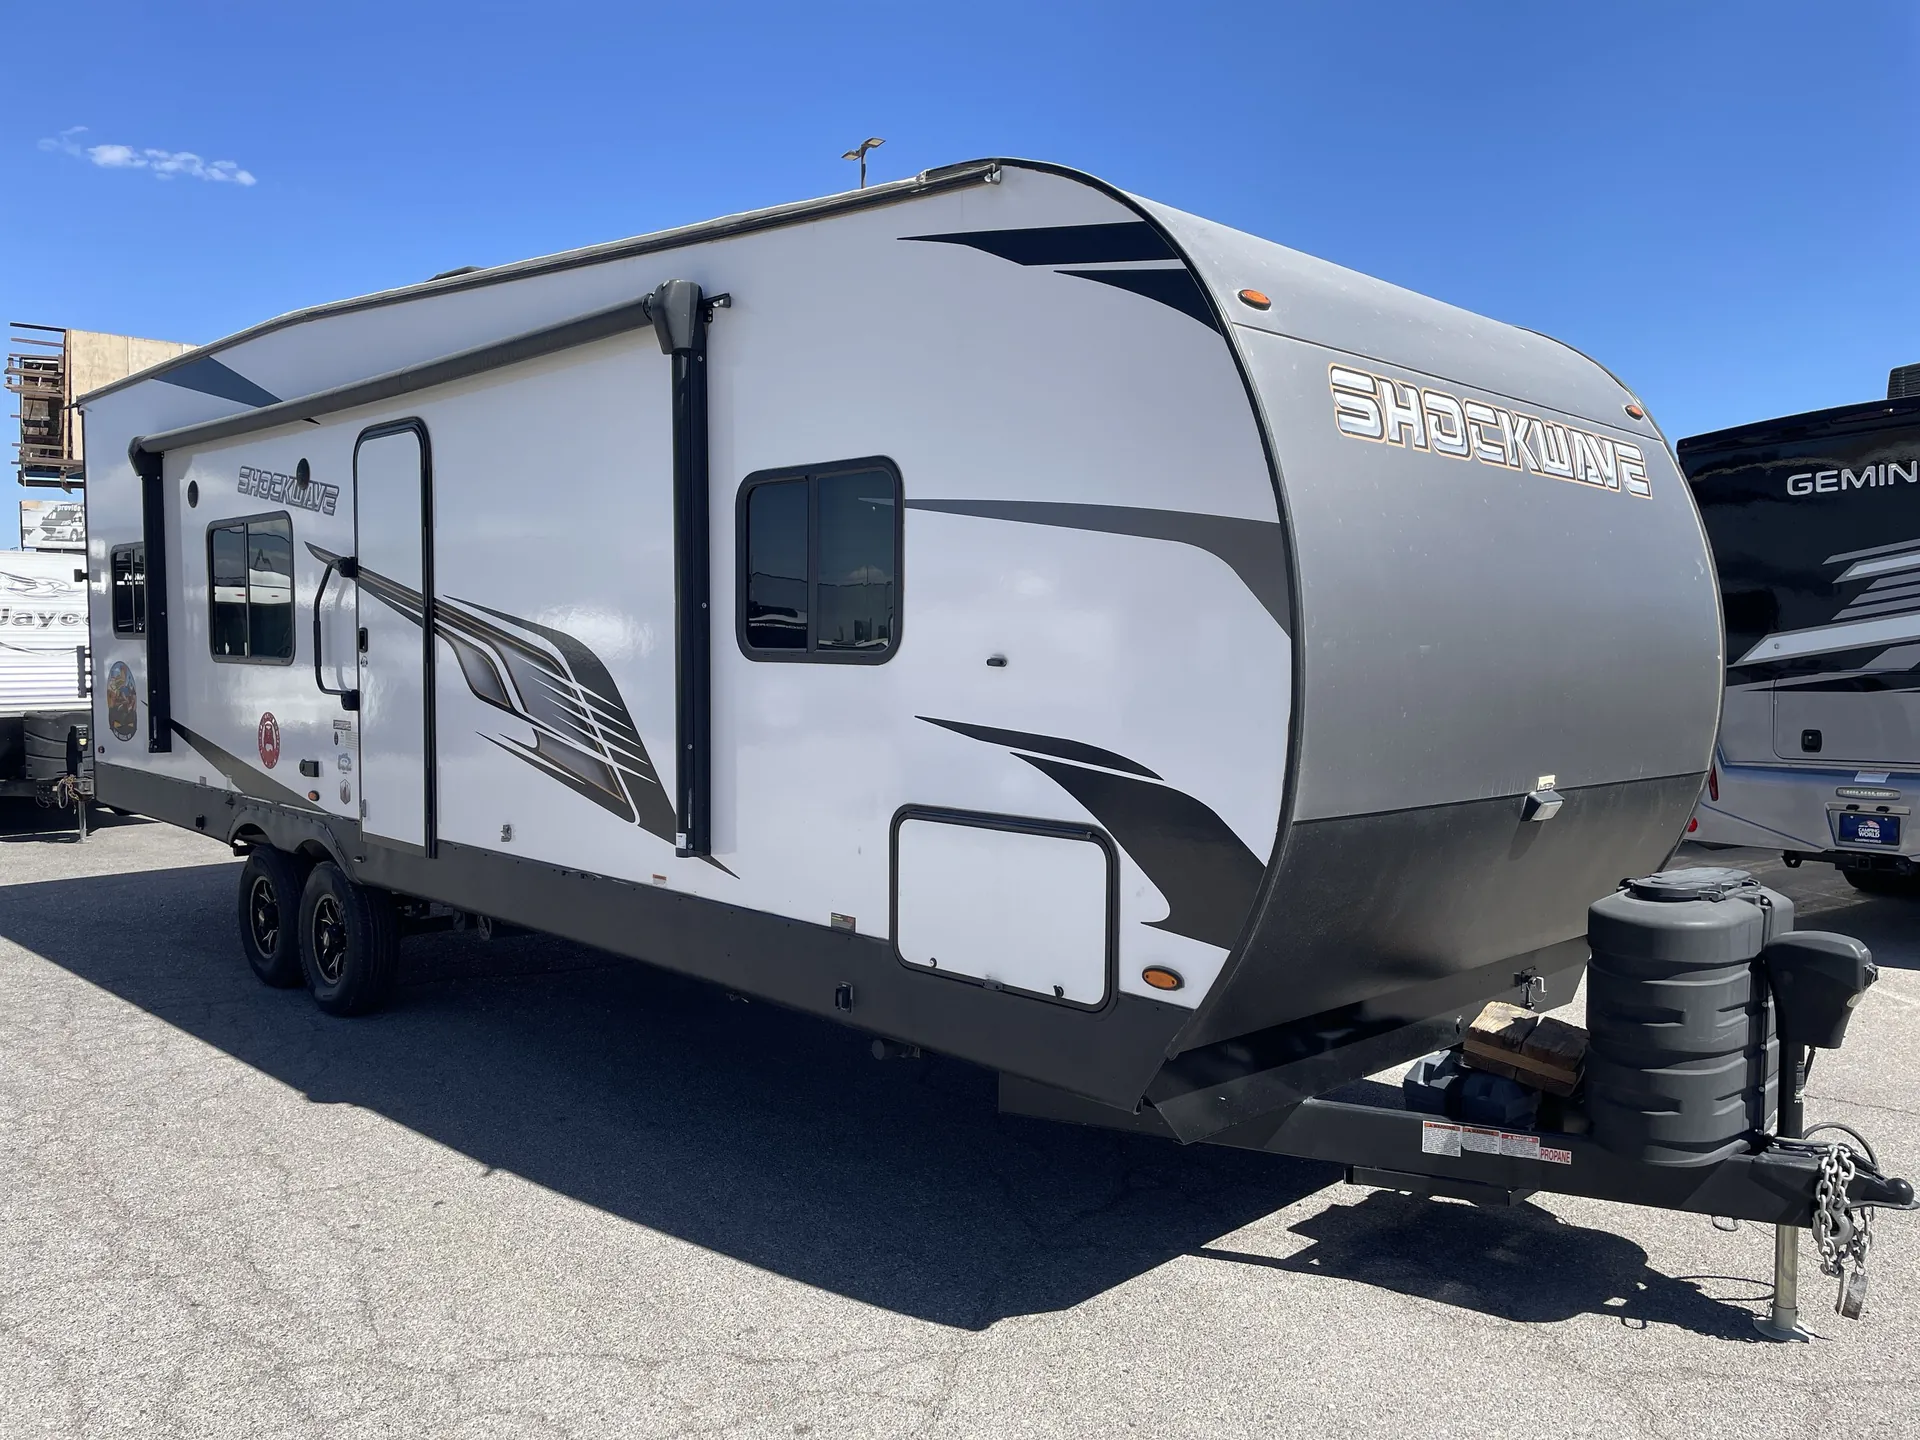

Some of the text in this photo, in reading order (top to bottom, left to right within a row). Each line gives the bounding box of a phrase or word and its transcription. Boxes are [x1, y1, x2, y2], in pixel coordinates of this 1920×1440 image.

[1329, 363, 1652, 499] SHOCKWAVE
[238, 465, 340, 516] SHOCKWAVE
[1787, 460, 1918, 496] GEMIN
[0, 606, 89, 629] Jayc
[1540, 1148, 1571, 1164] PROPANE
